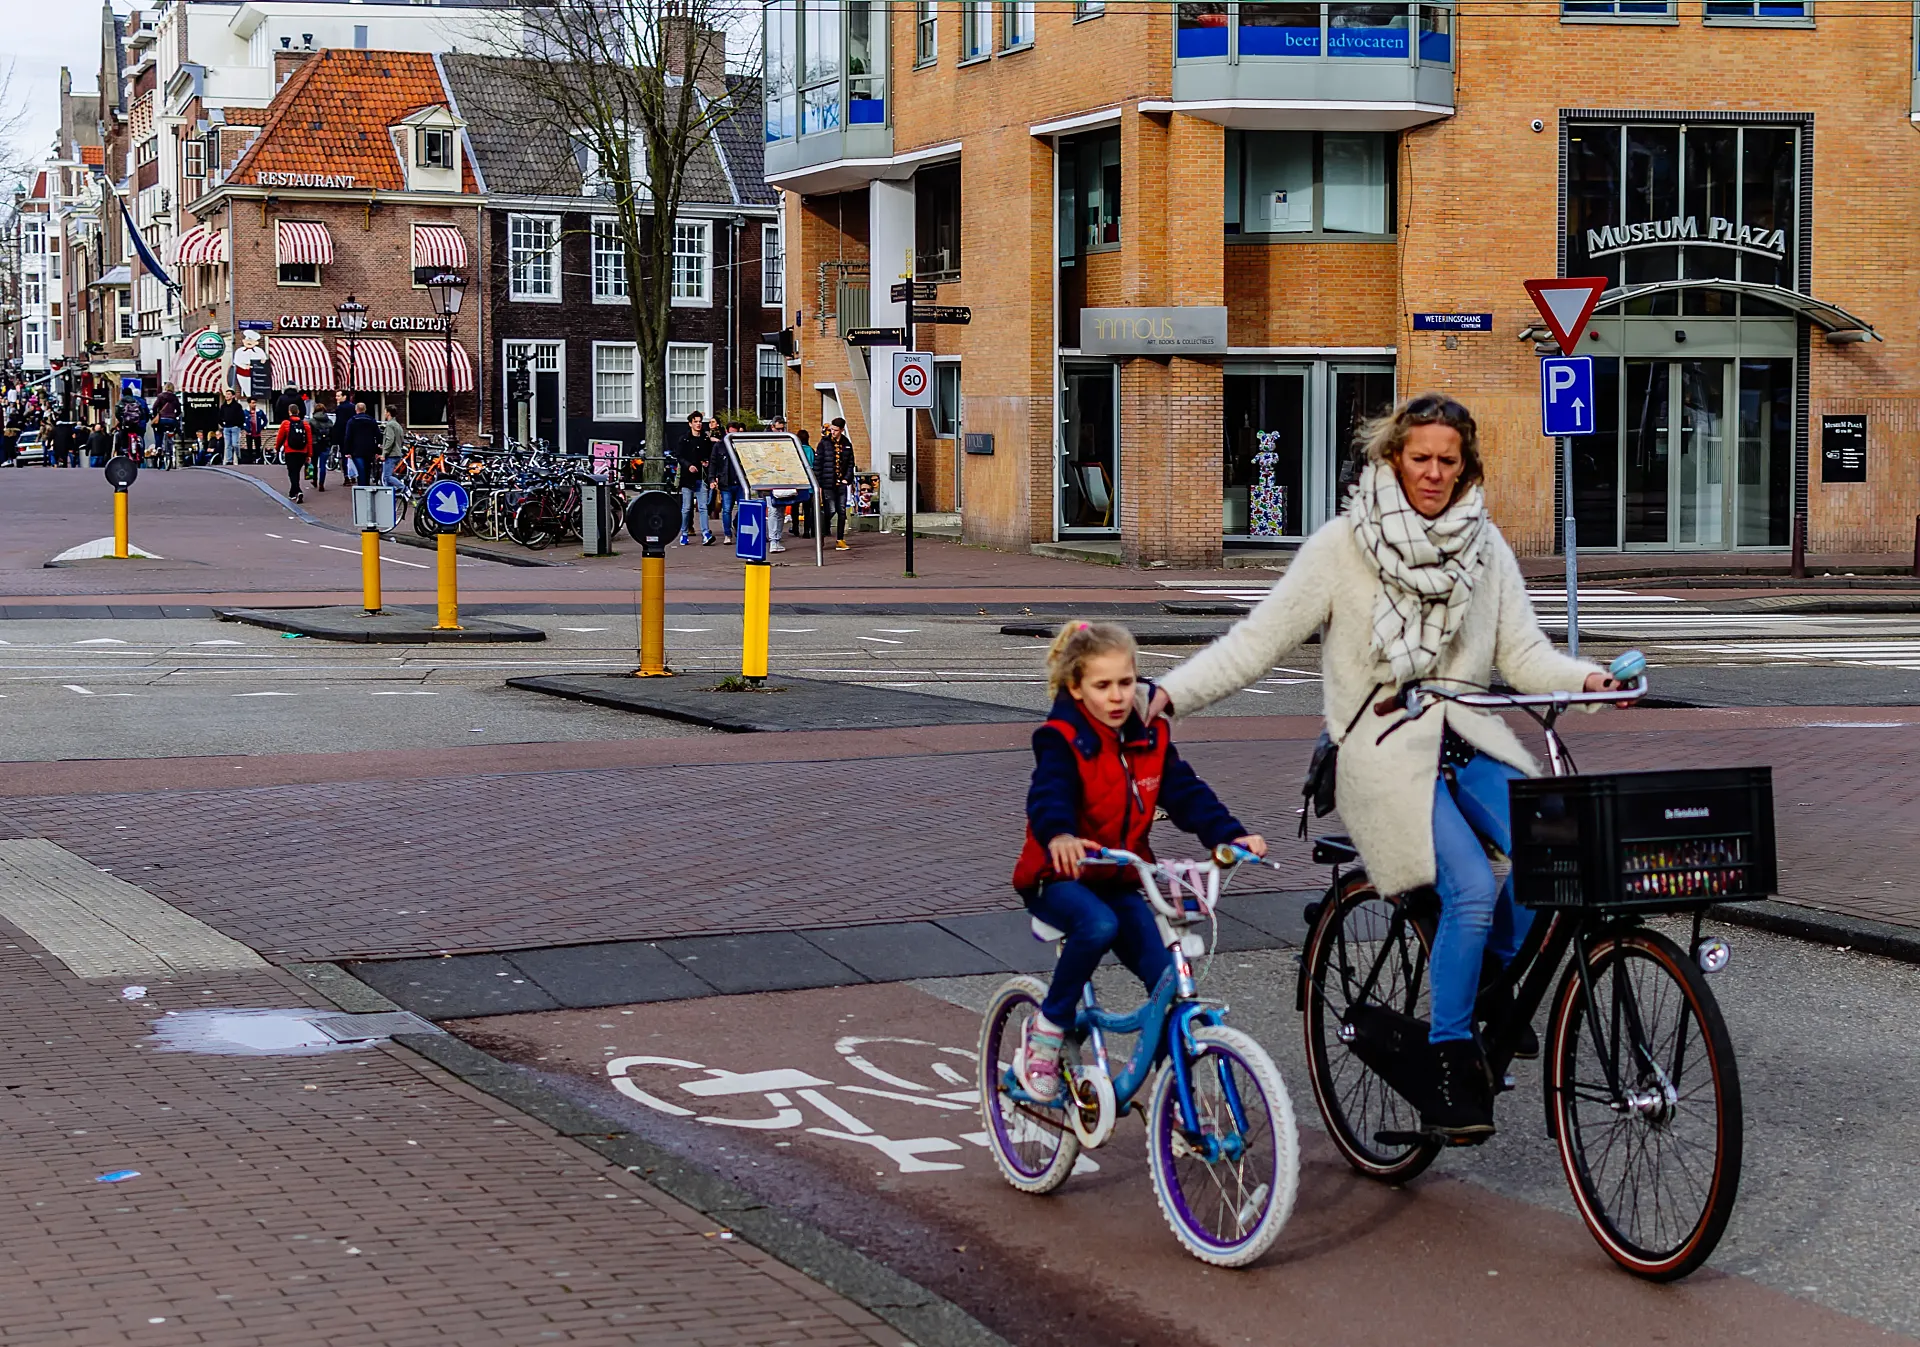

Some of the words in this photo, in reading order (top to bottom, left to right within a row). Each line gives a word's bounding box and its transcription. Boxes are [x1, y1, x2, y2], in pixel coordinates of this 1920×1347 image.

[1285, 32, 1319, 47] beer
[1328, 33, 1404, 48] advocaten
[257, 171, 355, 188] RESTAURANT
[1586, 215, 1698, 252] MUSEUM
[1708, 216, 1786, 253] PLAZA
[280, 315, 321, 329] CAFE
[325, 315, 368, 329] HS
[371, 319, 387, 329] en
[1424, 315, 1481, 323] WETERINGSCHANS
[903, 374, 922, 386] 30
[1549, 365, 1576, 404] P
